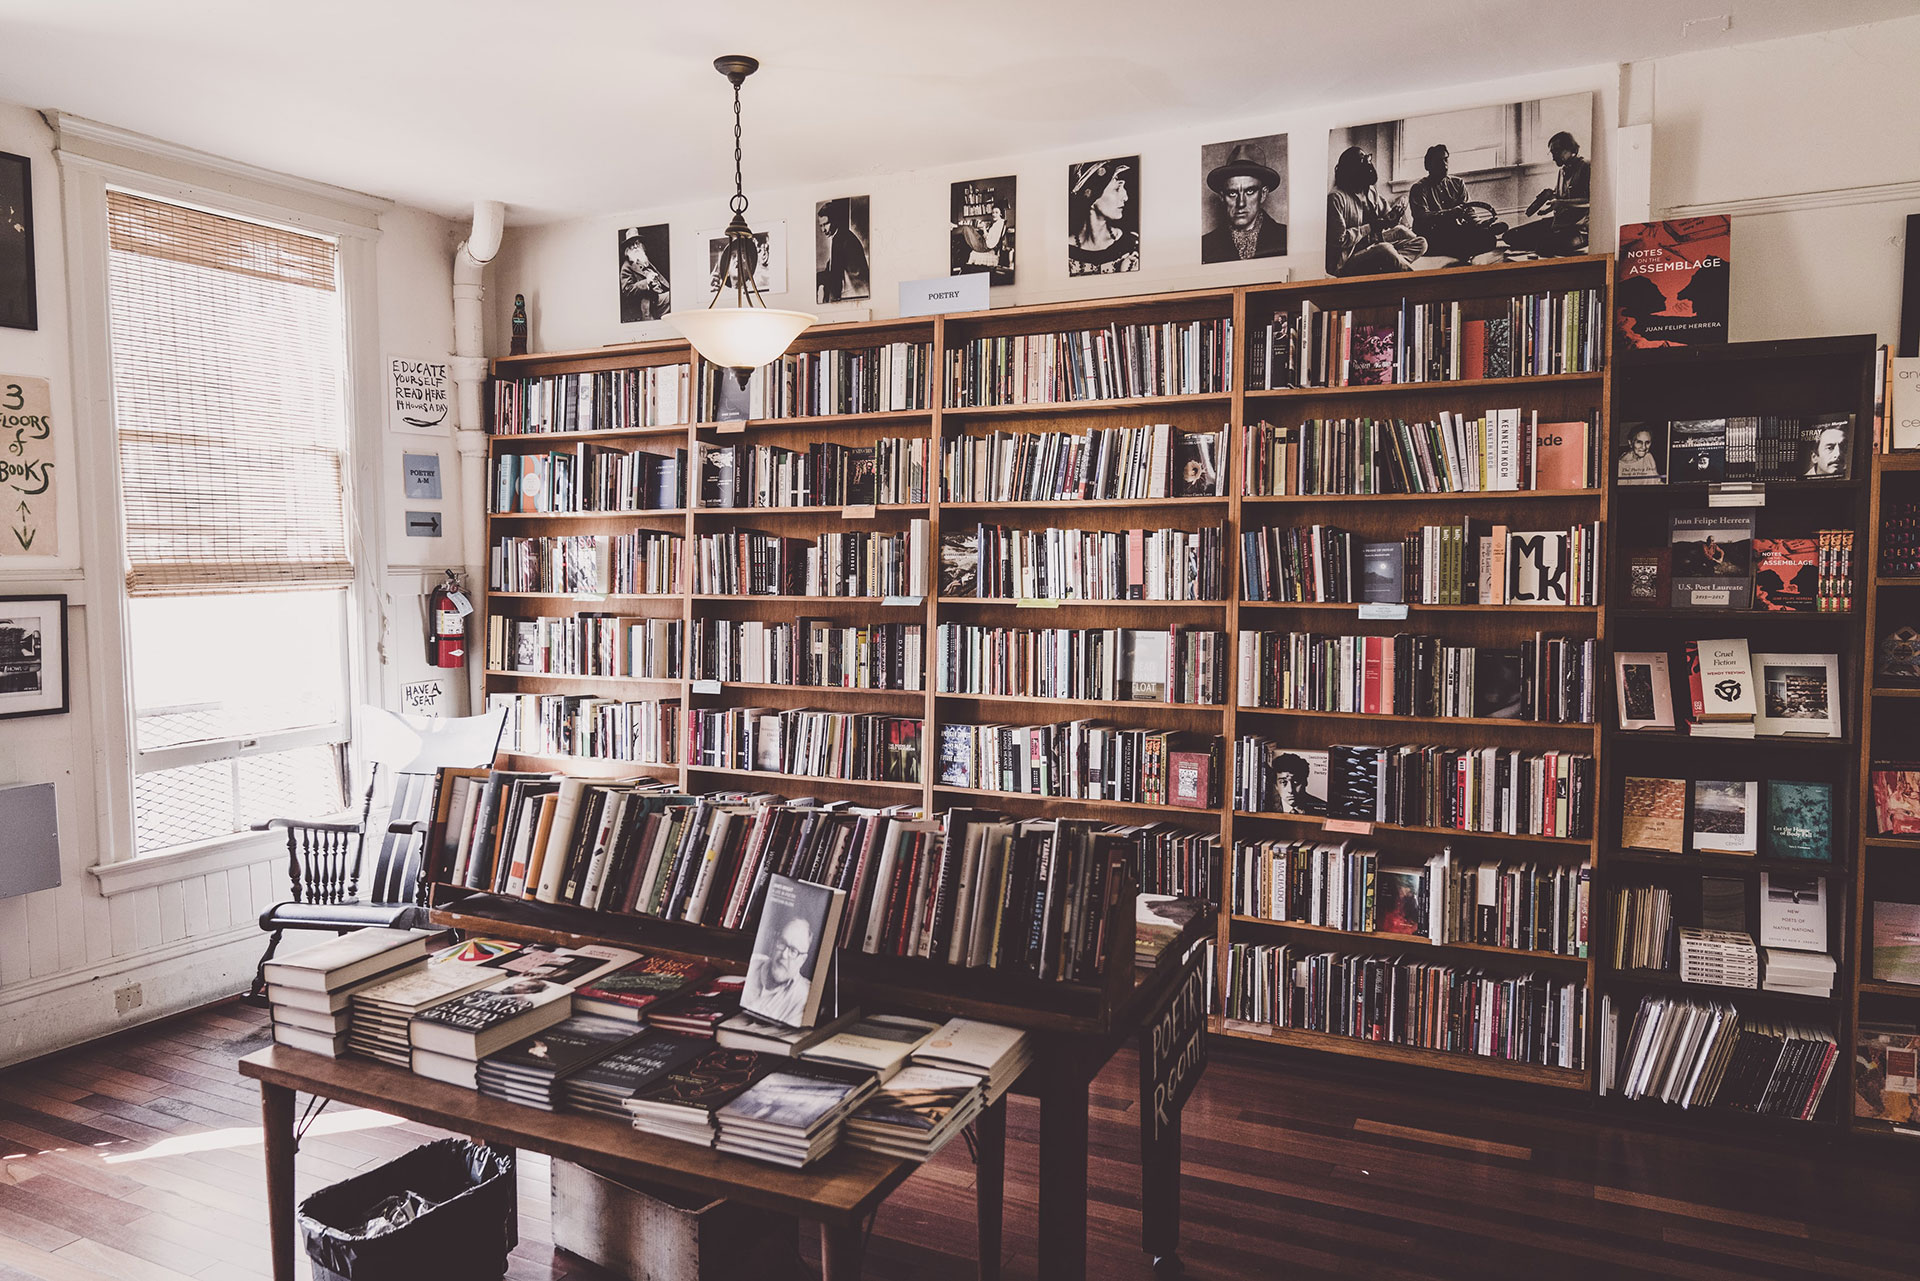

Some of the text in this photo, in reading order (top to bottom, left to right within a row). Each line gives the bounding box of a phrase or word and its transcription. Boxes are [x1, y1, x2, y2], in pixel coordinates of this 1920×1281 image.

[1628, 249, 1663, 258] NOTES
[1629, 257, 1721, 275] ASSEMBLAGE
[928, 290, 960, 301] POETRY
[1688, 322, 1721, 330] HERRERA
[393, 360, 447, 378] EDUCATE
[393, 373, 443, 388] YOURSELF
[2, 384, 24, 410] 3
[396, 387, 447, 402] READ HERE
[397, 400, 448, 412] 14 HOURS A DAY
[1501, 419, 1509, 454] KENNETH
[1801, 429, 1822, 437] STRAY
[9, 428, 27, 457] of
[410, 469, 435, 477] POETRY
[1673, 518, 1692, 526] Juan
[1694, 517, 1717, 526] Felipe
[1714, 650, 1734, 658] Cruel
[1713, 659, 1736, 667] Fiction
[406, 682, 442, 701] HAVE A
[1132, 683, 1156, 693] FLOAT
[412, 694, 437, 706] SEAT
[1276, 862, 1285, 902] MACHADO
[1152, 953, 1206, 1080] POETRY
[1154, 1019, 1206, 1141] Room!
